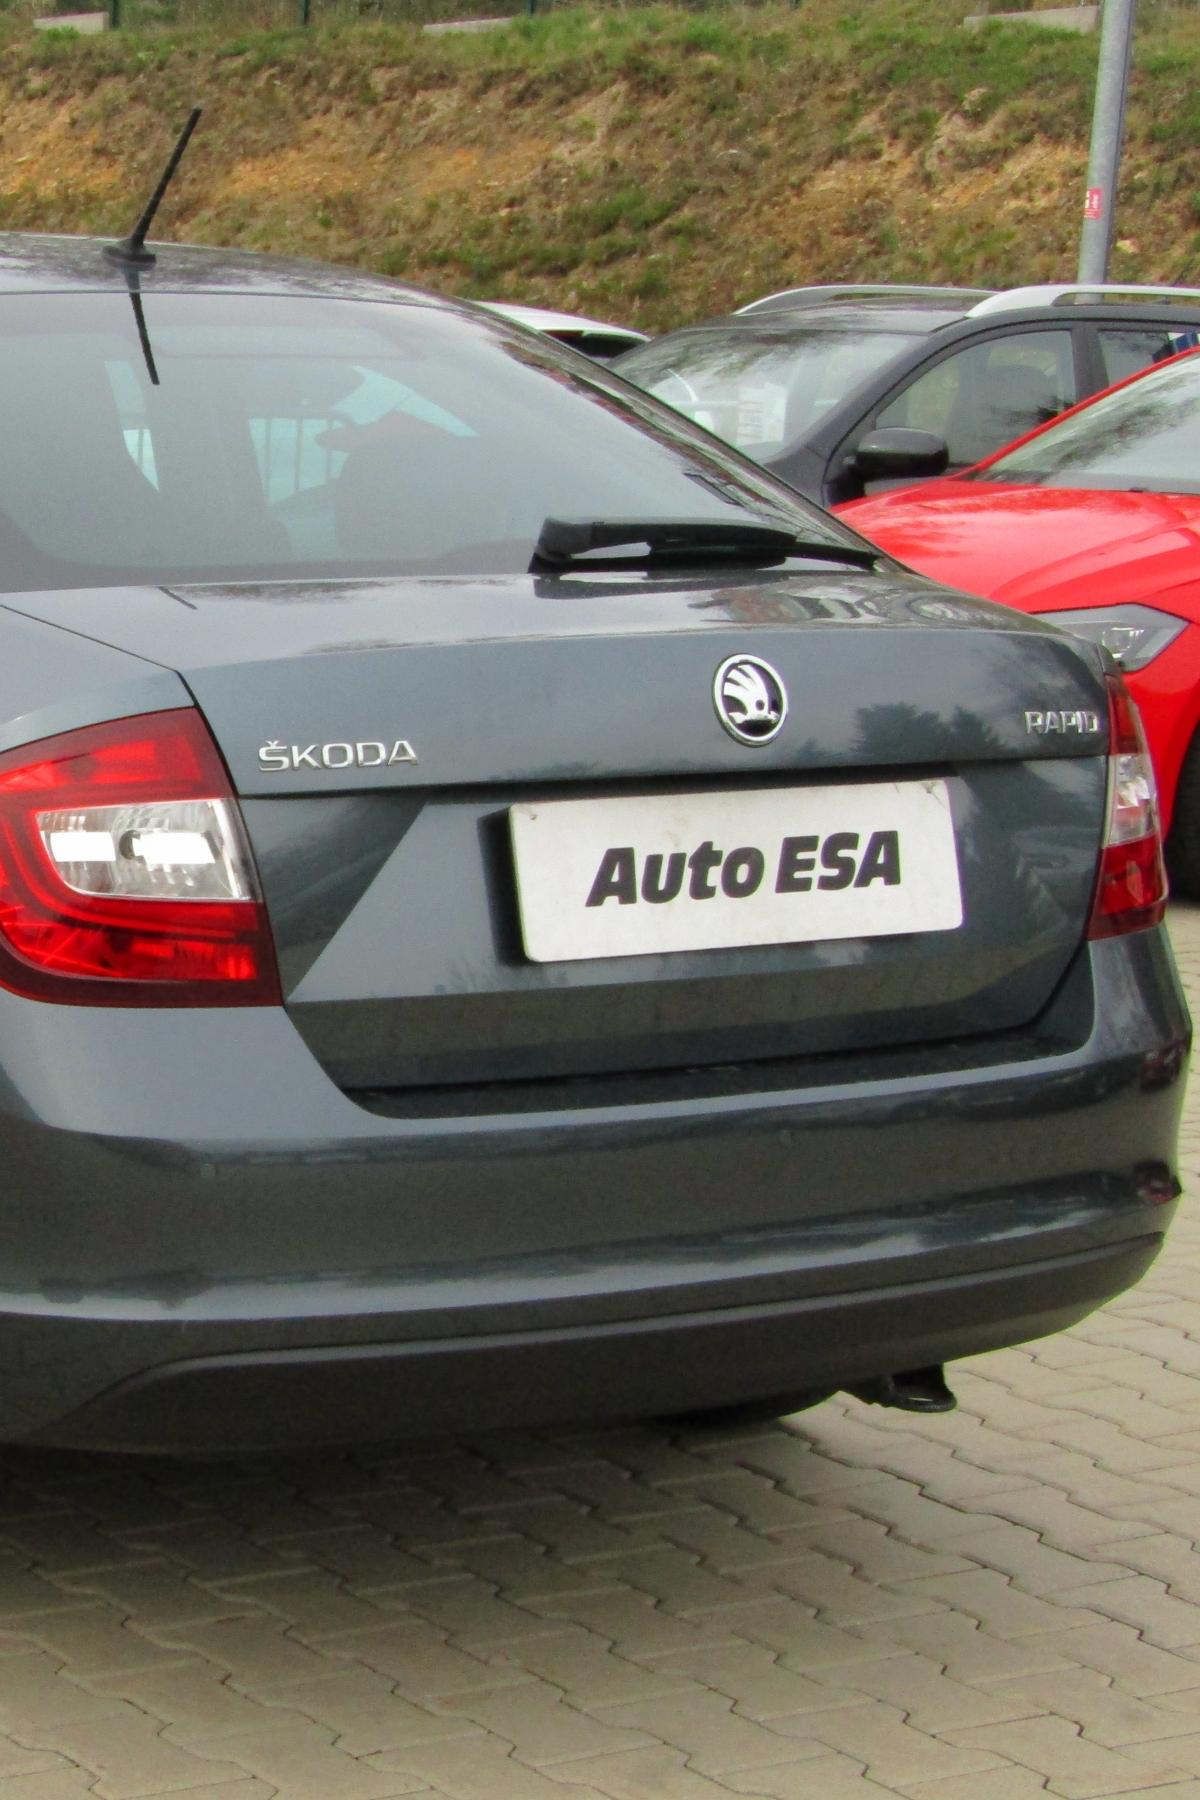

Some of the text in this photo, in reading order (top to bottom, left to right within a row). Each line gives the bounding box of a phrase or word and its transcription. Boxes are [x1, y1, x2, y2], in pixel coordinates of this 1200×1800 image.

[1024, 710, 1099, 734] RAPID
[258, 740, 418, 772] ŠKODA
[585, 830, 901, 907] Auto ESA
